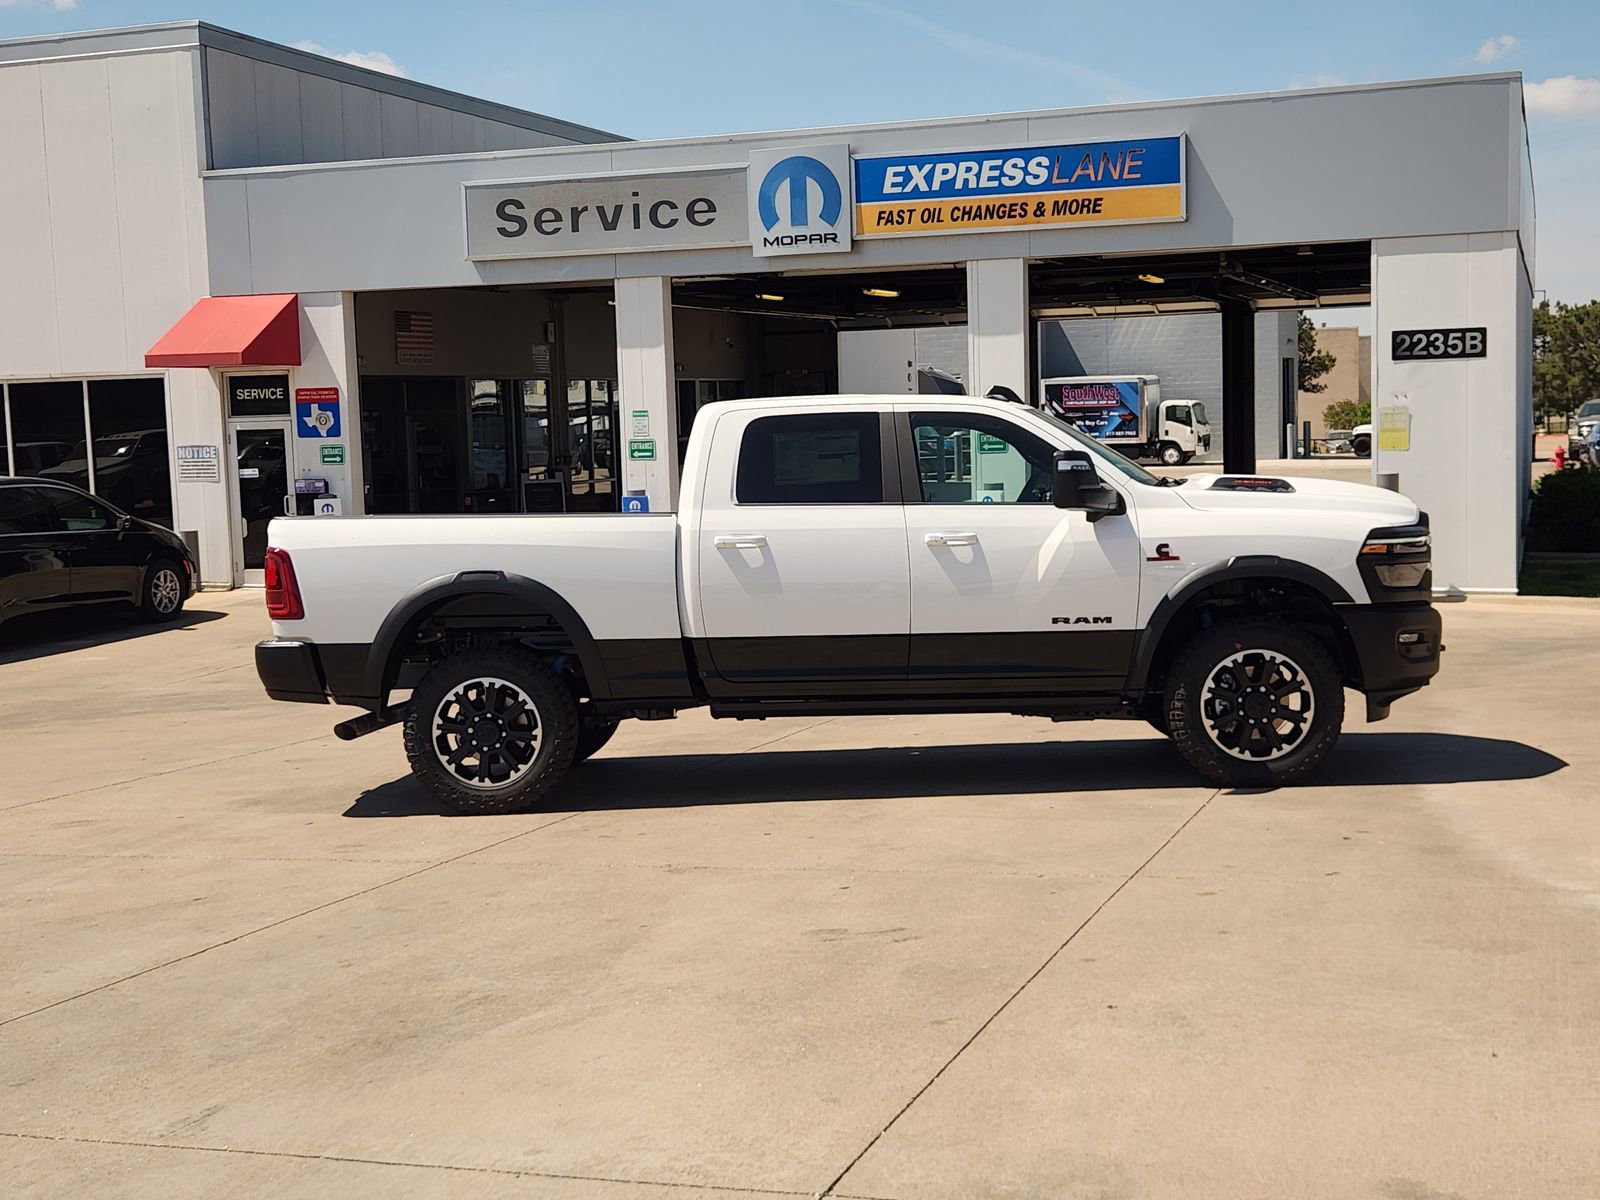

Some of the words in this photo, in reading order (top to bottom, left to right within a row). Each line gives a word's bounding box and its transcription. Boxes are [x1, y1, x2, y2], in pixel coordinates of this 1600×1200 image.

[495, 191, 717, 238] Service
[876, 208, 917, 227] FAST
[920, 206, 945, 224] OIL
[950, 202, 1028, 222] CHANGES
[1033, 201, 1046, 217] &
[1051, 197, 1104, 216] MORE
[763, 233, 841, 248] MOPAR
[1395, 332, 1483, 356] 2235B
[236, 388, 285, 400] SERVICE
[177, 446, 217, 459] NOTICE
[322, 447, 343, 455] ENTRANCE
[1051, 616, 1113, 625] RAM
